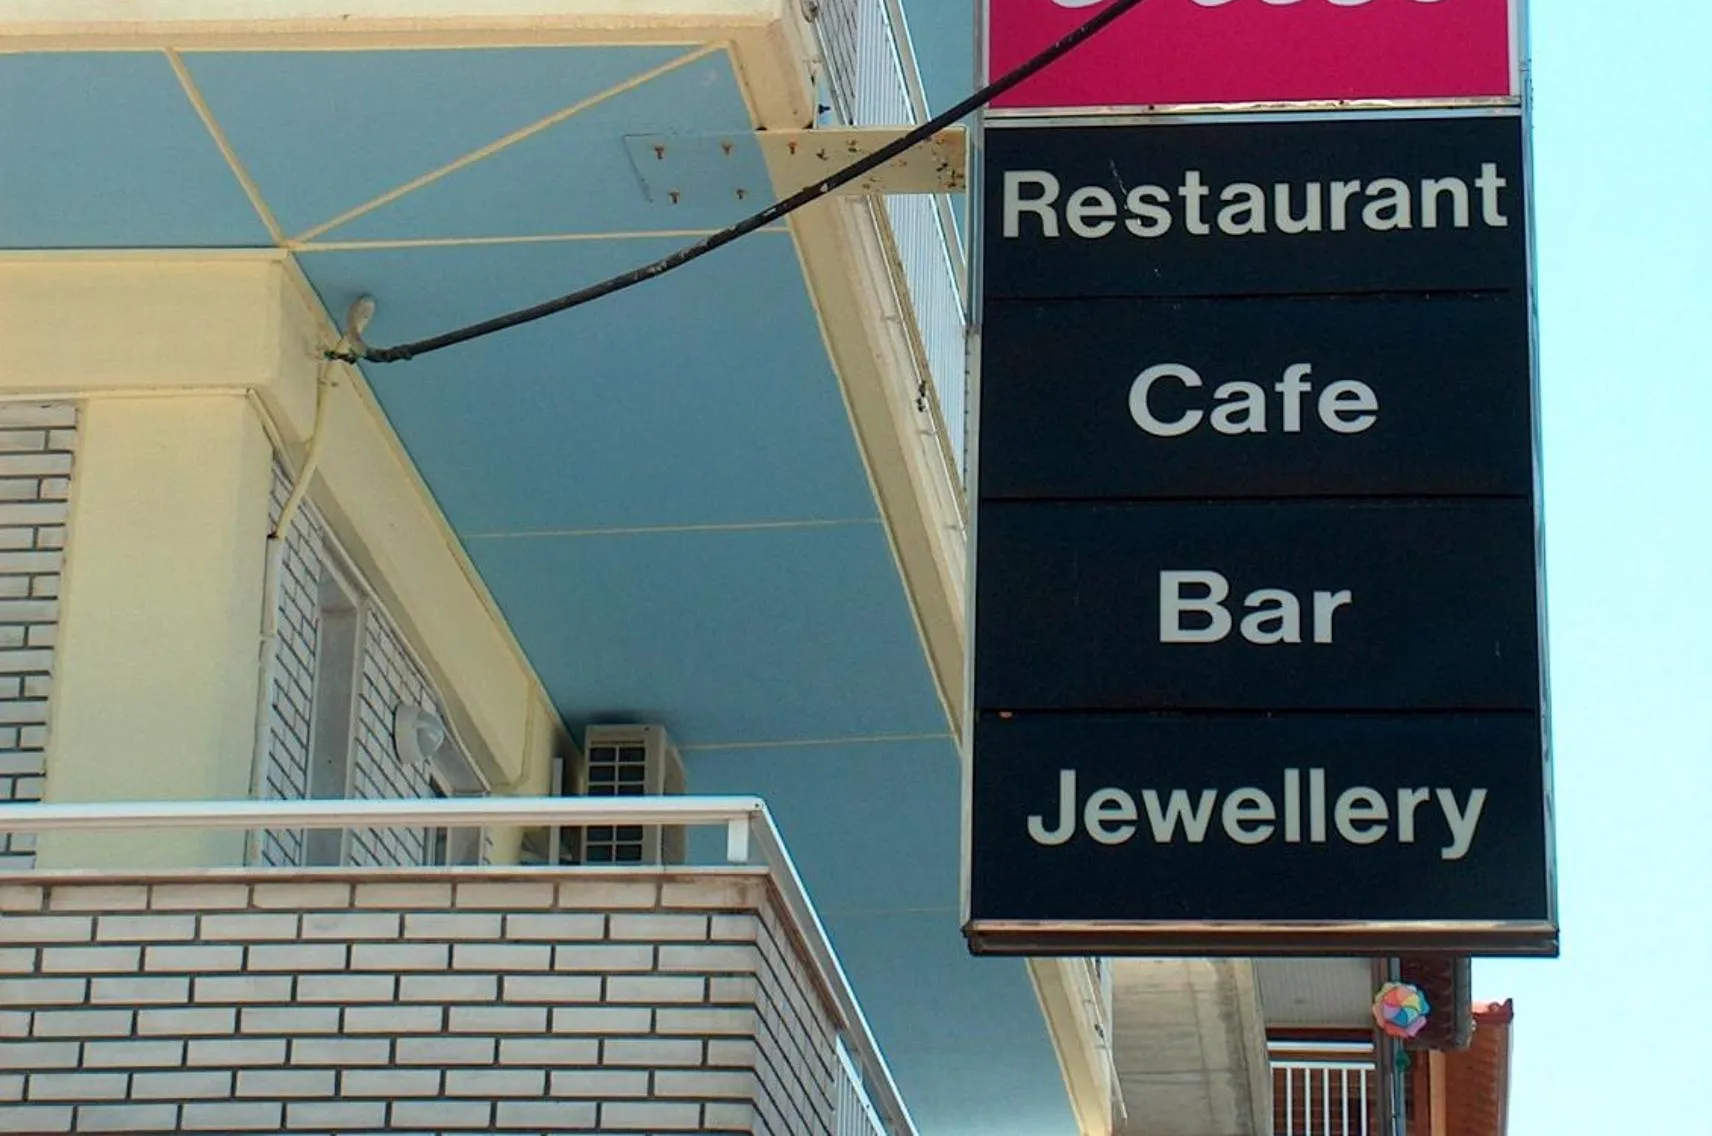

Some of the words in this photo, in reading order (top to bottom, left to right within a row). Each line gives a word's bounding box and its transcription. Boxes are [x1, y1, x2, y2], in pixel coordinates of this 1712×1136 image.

[1001, 162, 1507, 239] Restaurant
[1127, 363, 1379, 436] Cafe
[1158, 570, 1352, 644] Bar
[1027, 768, 1488, 861] Jewellery
